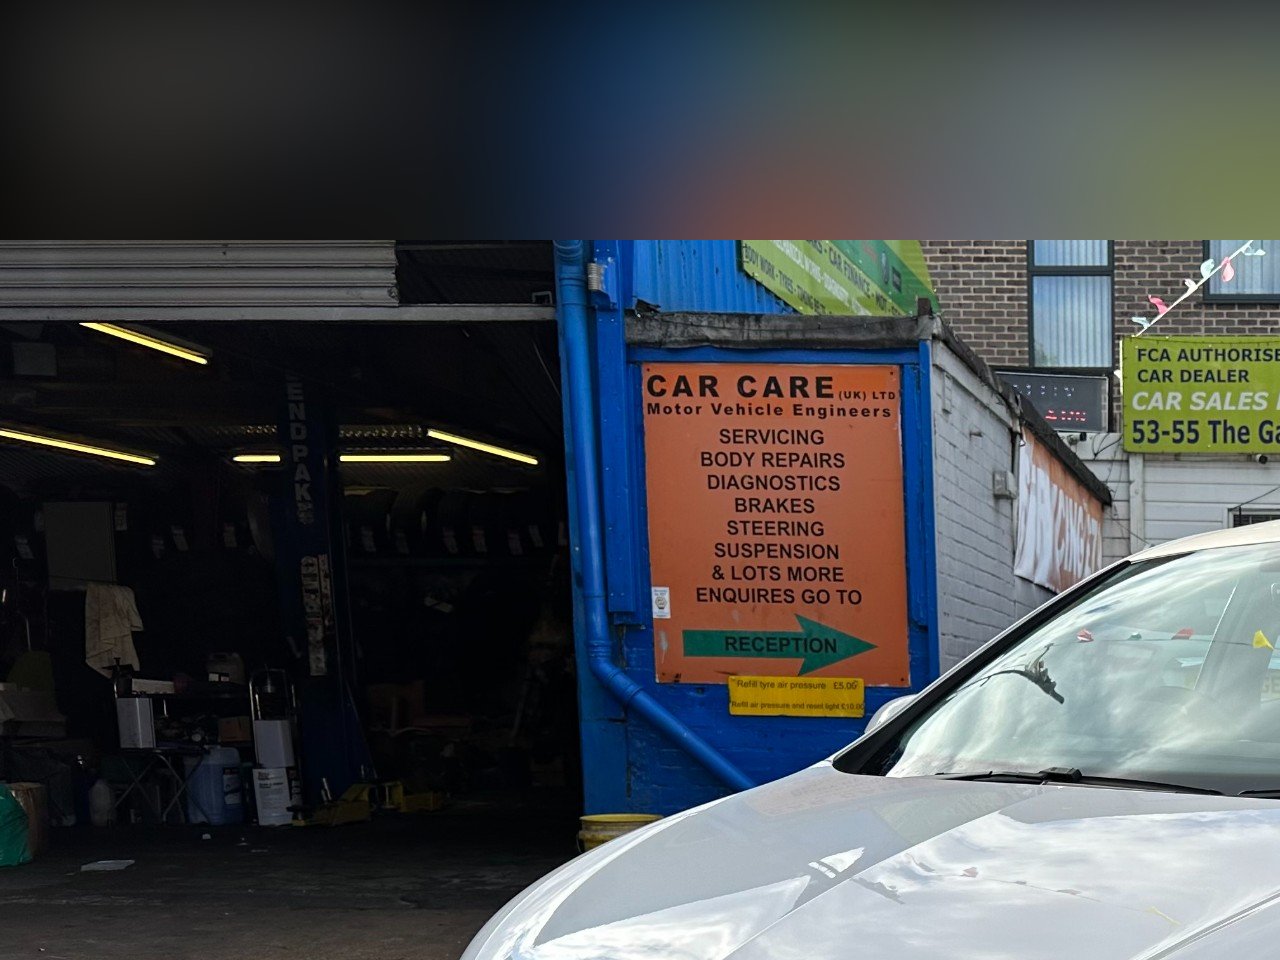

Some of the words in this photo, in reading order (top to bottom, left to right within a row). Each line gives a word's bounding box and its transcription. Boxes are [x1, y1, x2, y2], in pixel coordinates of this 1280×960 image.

[1137, 348, 1171, 362] FCA
[1137, 369, 1174, 383] CAR
[1180, 369, 1250, 383] DEALER
[646, 374, 718, 398] CAR
[736, 375, 834, 399] CARE
[838, 390, 867, 402] (UK)
[872, 391, 896, 400] LTD
[1132, 391, 1182, 411] CAR
[1190, 391, 1269, 411] SALES
[647, 403, 702, 416] Motor
[711, 403, 784, 416] Vehicle
[792, 404, 892, 420] Engineers
[719, 428, 825, 446] SERVICING
[1132, 419, 1200, 444] 53-55
[1208, 419, 1250, 444] The
[700, 452, 756, 468] BODY
[762, 452, 846, 469] REPAIRS
[707, 474, 841, 492] DIAGNOSTICS
[734, 498, 815, 514] BRAKES
[726, 520, 825, 537] STEERING
[714, 542, 840, 560] SUSPENSION
[712, 565, 725, 581] &
[731, 566, 781, 582] LOTS
[787, 566, 844, 582] MORE
[696, 587, 796, 604] ENQUIRES
[801, 589, 830, 605] GO
[836, 589, 862, 605] TO
[724, 636, 838, 654] RECEPTION
[736, 680, 758, 688] Refill
[760, 681, 776, 691] tyre
[778, 681, 788, 689] air
[790, 682, 826, 691] pressure
